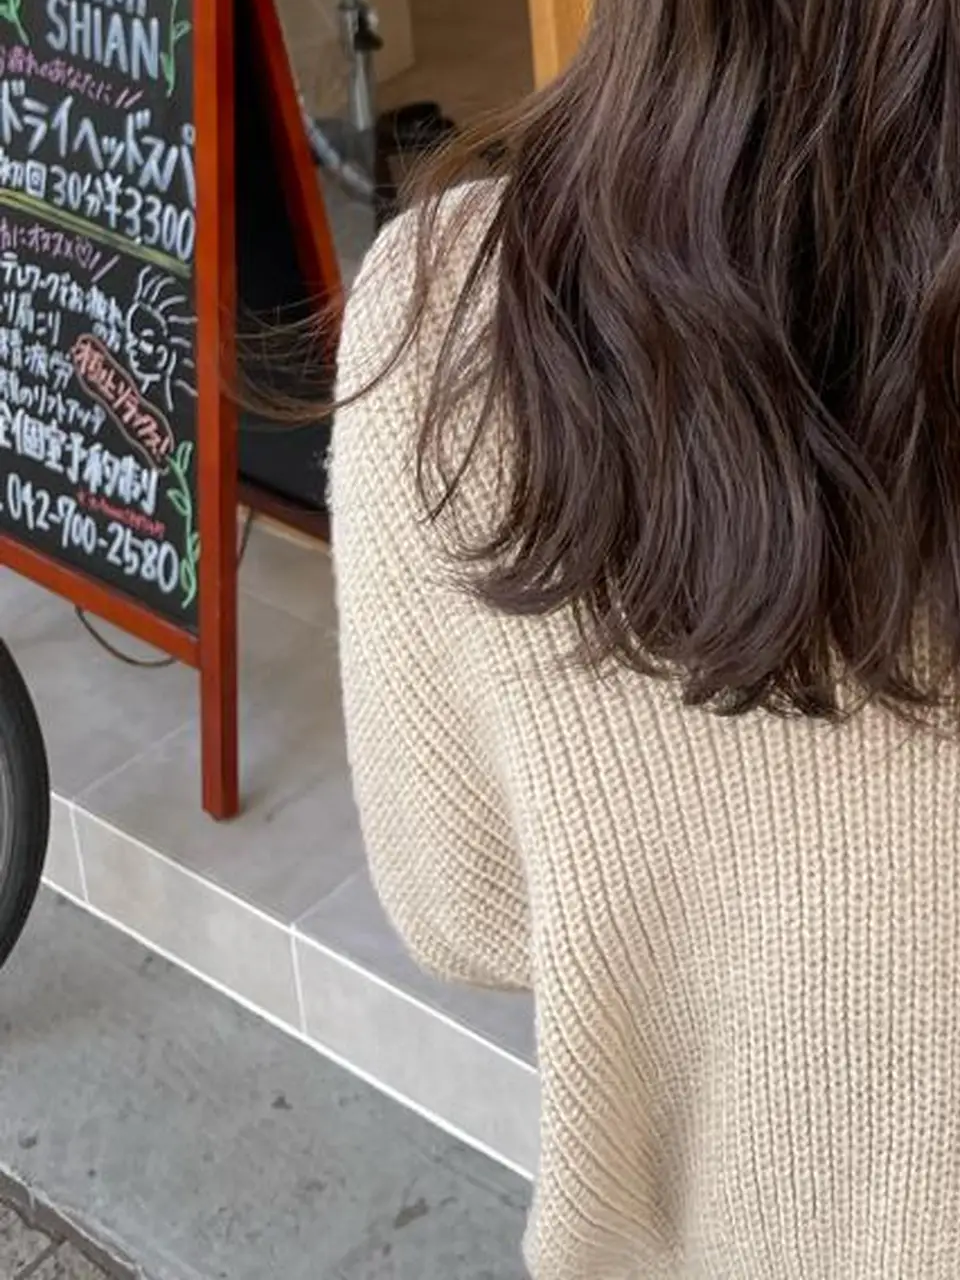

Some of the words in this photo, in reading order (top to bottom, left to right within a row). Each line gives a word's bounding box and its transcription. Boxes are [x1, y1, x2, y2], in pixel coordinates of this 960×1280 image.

[1, 80, 196, 207] ドライヘッドスパ
[0, 291, 61, 345] り肩こり
